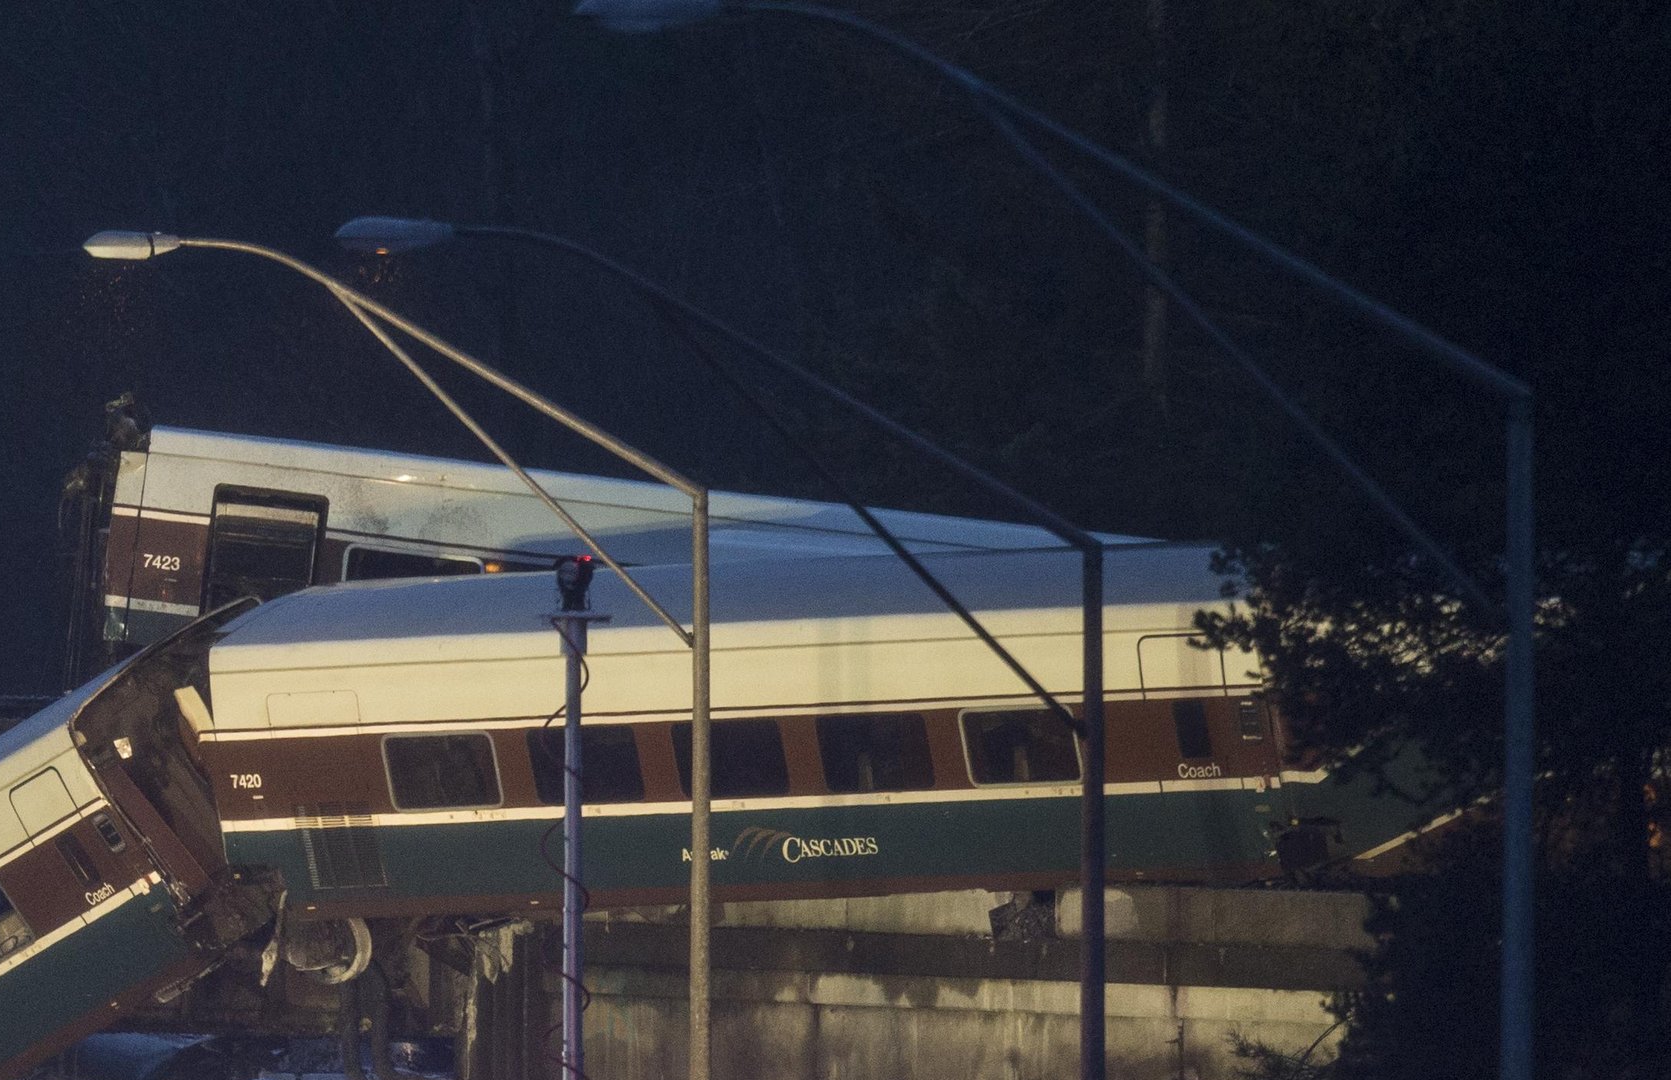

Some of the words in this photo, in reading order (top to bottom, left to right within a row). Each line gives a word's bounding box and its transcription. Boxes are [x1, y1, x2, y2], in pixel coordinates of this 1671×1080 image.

[143, 553, 180, 571] 7423
[1178, 762, 1221, 778] Coach
[230, 773, 262, 789] 7420
[682, 847, 727, 862] Aak
[782, 836, 878, 863] CASCADES
[85, 882, 115, 905] Coach
